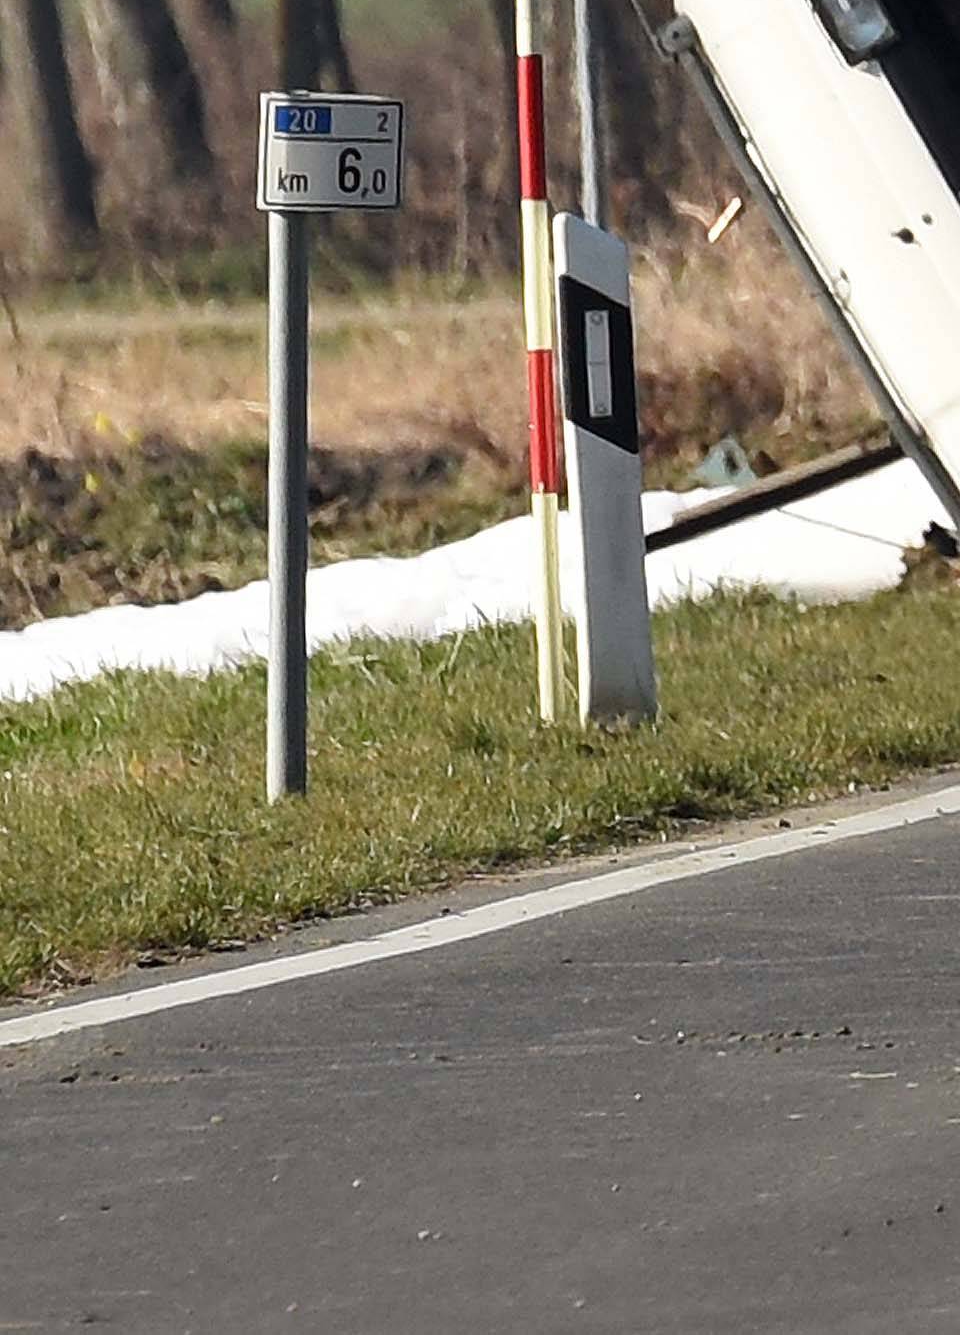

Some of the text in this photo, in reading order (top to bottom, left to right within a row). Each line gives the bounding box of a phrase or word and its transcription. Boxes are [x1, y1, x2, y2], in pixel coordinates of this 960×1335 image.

[289, 109, 389, 133] 20 2
[276, 147, 387, 199] km 6,0
